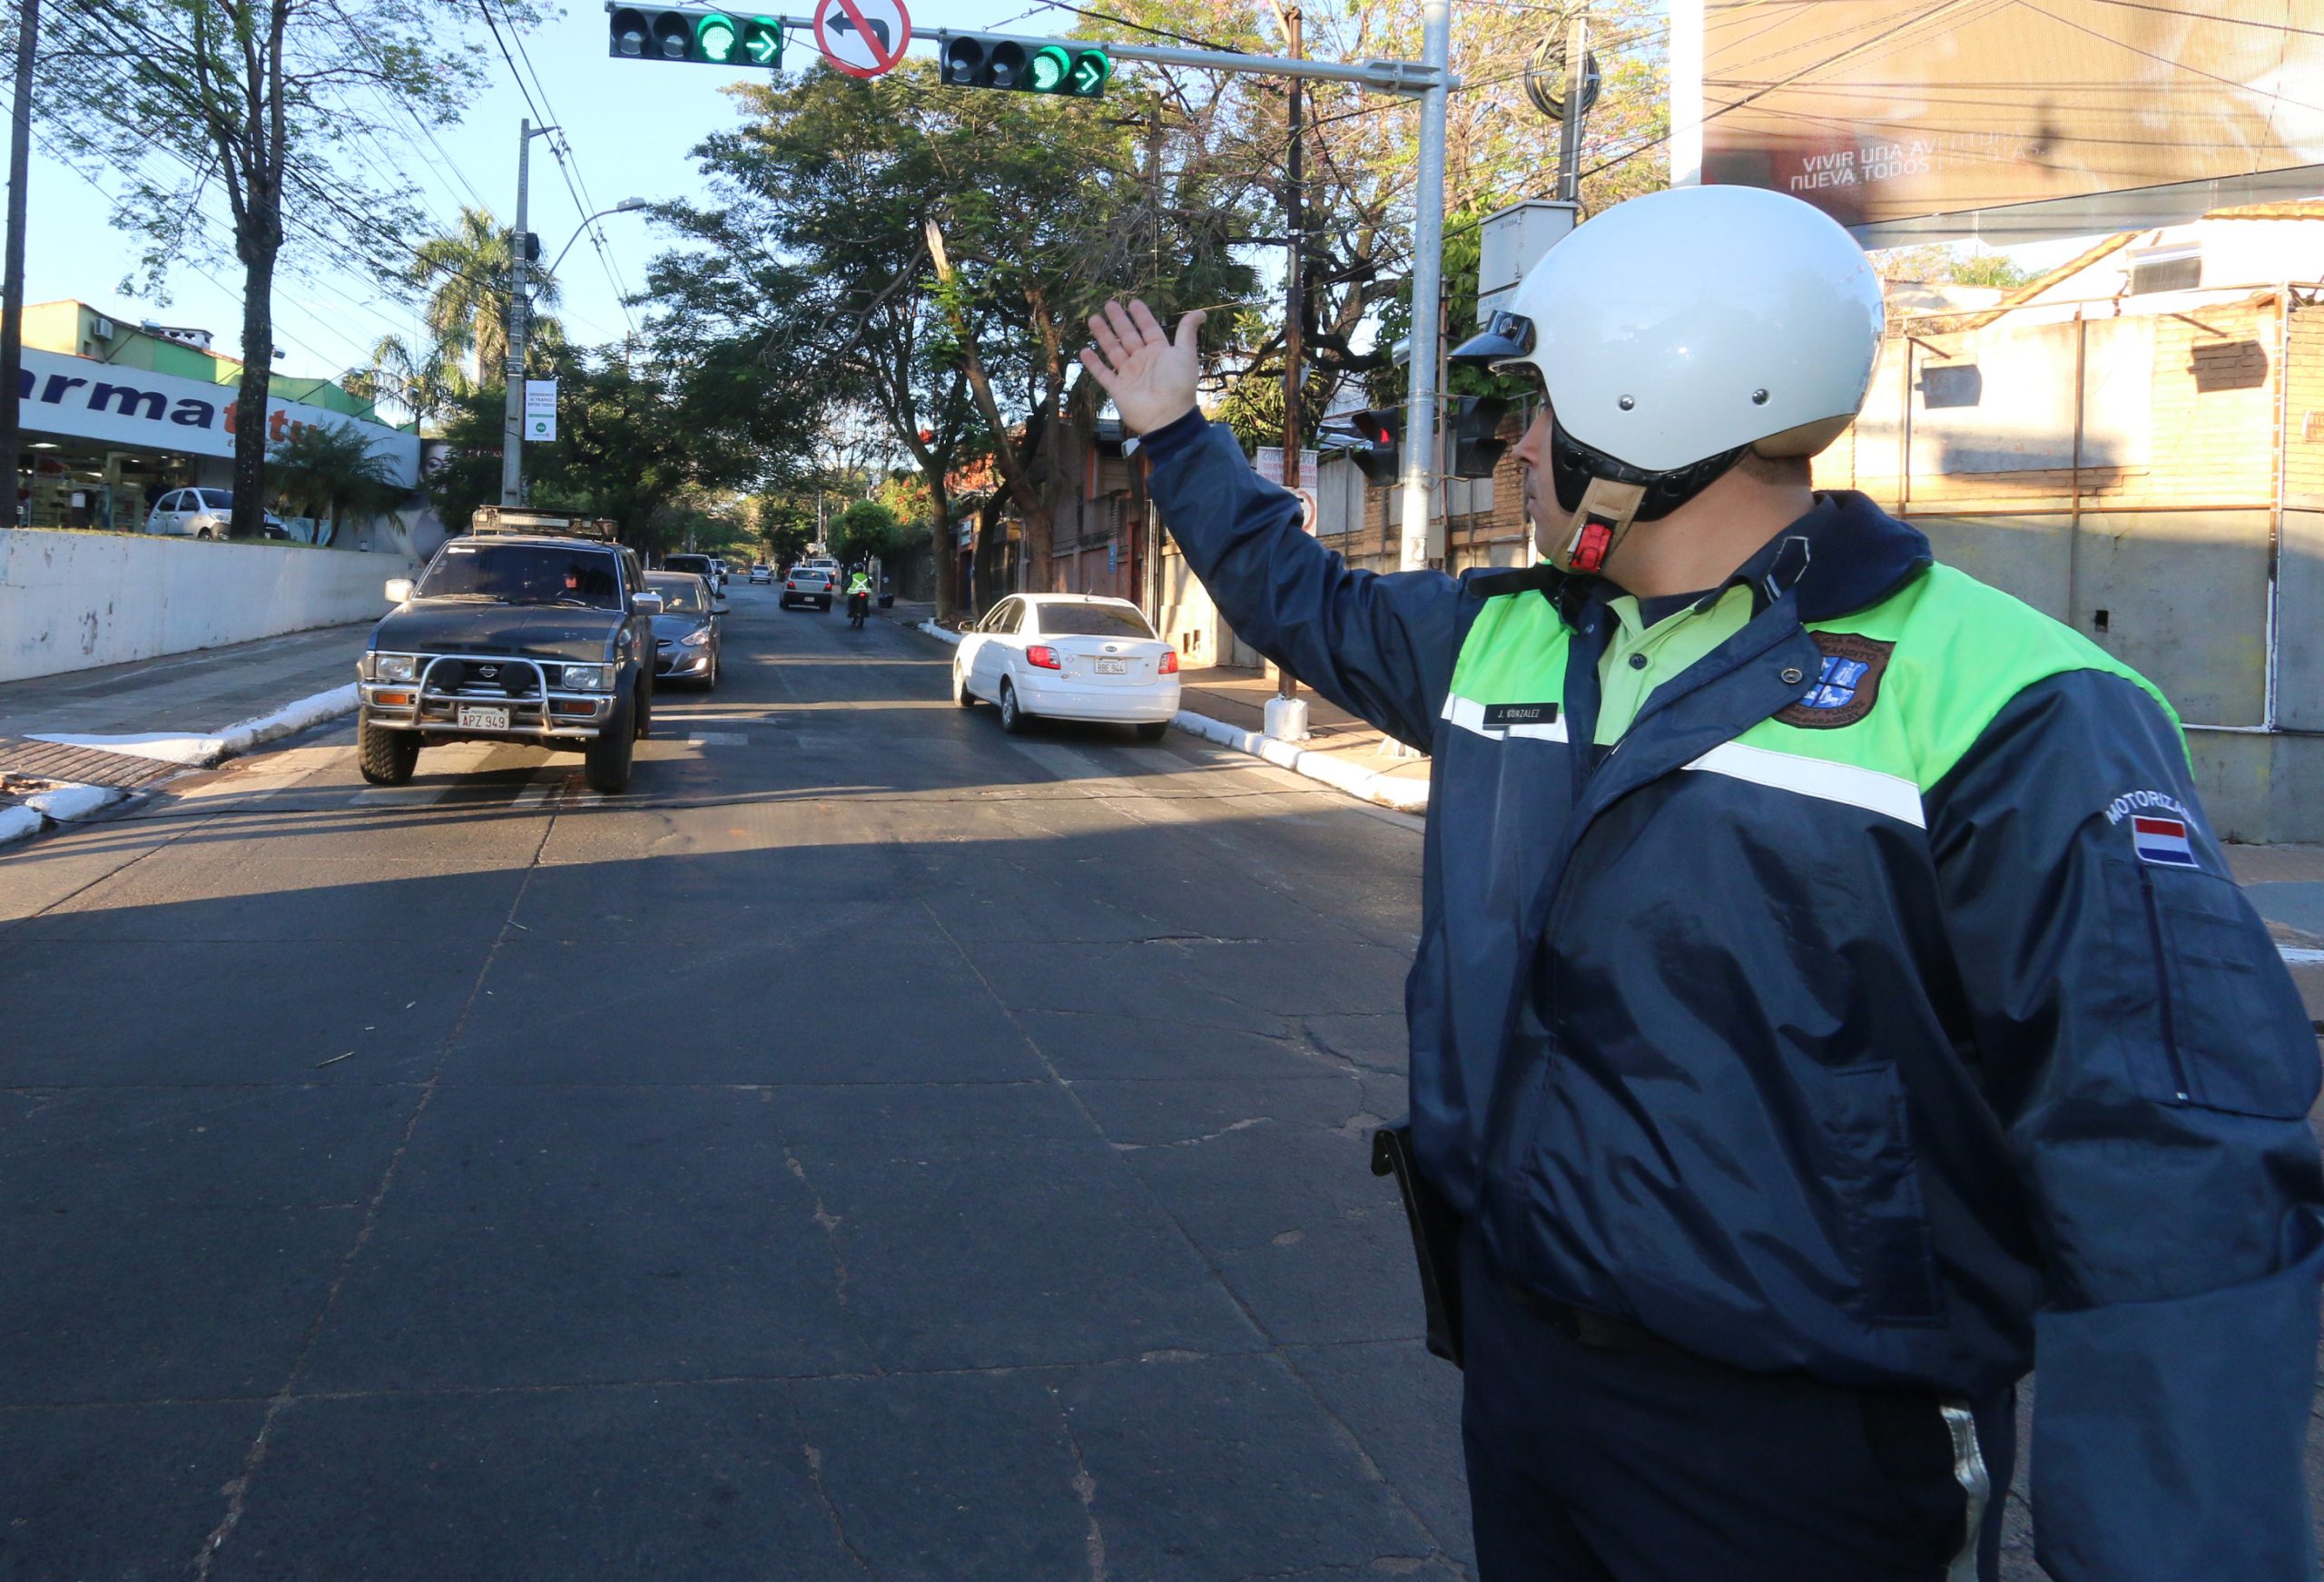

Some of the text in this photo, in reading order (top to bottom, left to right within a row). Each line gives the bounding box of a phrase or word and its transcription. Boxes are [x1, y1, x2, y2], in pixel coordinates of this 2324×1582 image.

[1802, 151, 1855, 172] VIVIR
[1861, 159, 1931, 182] TODOS
[463, 715, 505, 728] APZ 949
[1507, 709, 1540, 718] GONZALEZ
